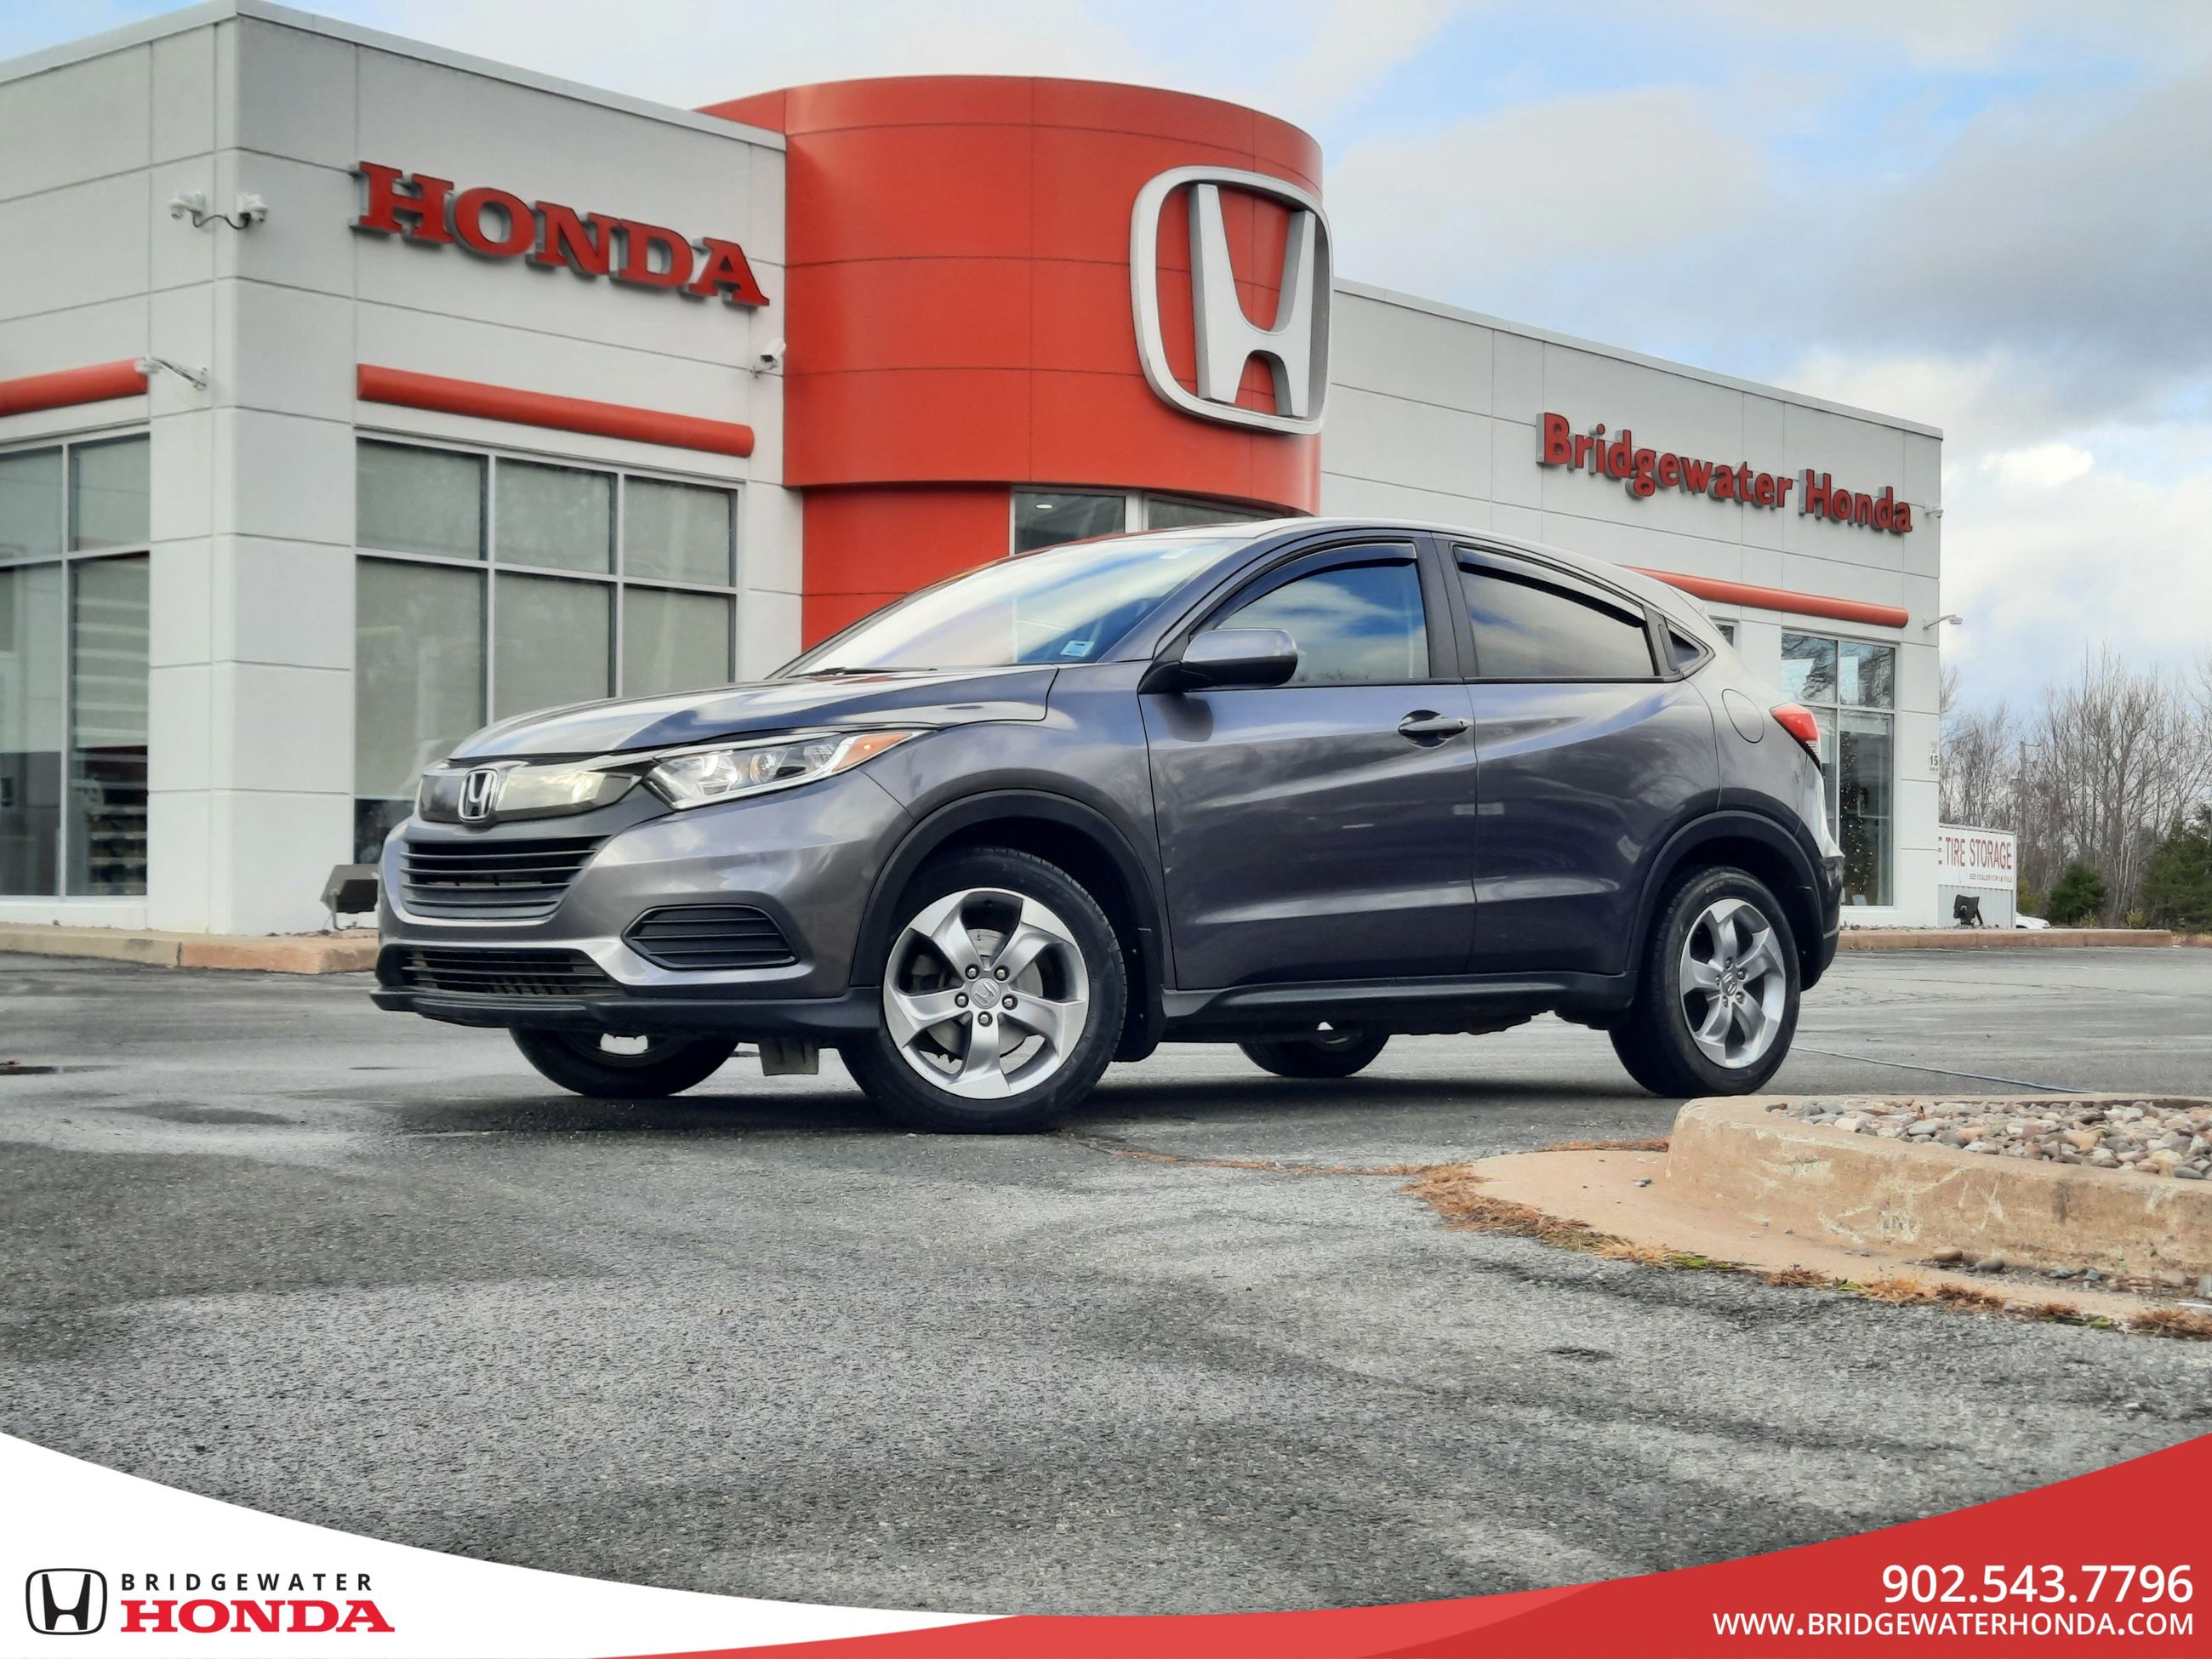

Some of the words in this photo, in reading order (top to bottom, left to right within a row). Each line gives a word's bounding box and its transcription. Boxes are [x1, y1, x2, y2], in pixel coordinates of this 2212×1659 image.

[354, 161, 770, 308] HONDA
[1541, 412, 1793, 509] Bridgewater
[1803, 469, 1913, 533] Honda
[1946, 836, 1966, 868] TIRE
[1970, 838, 2012, 869] STORAGE
